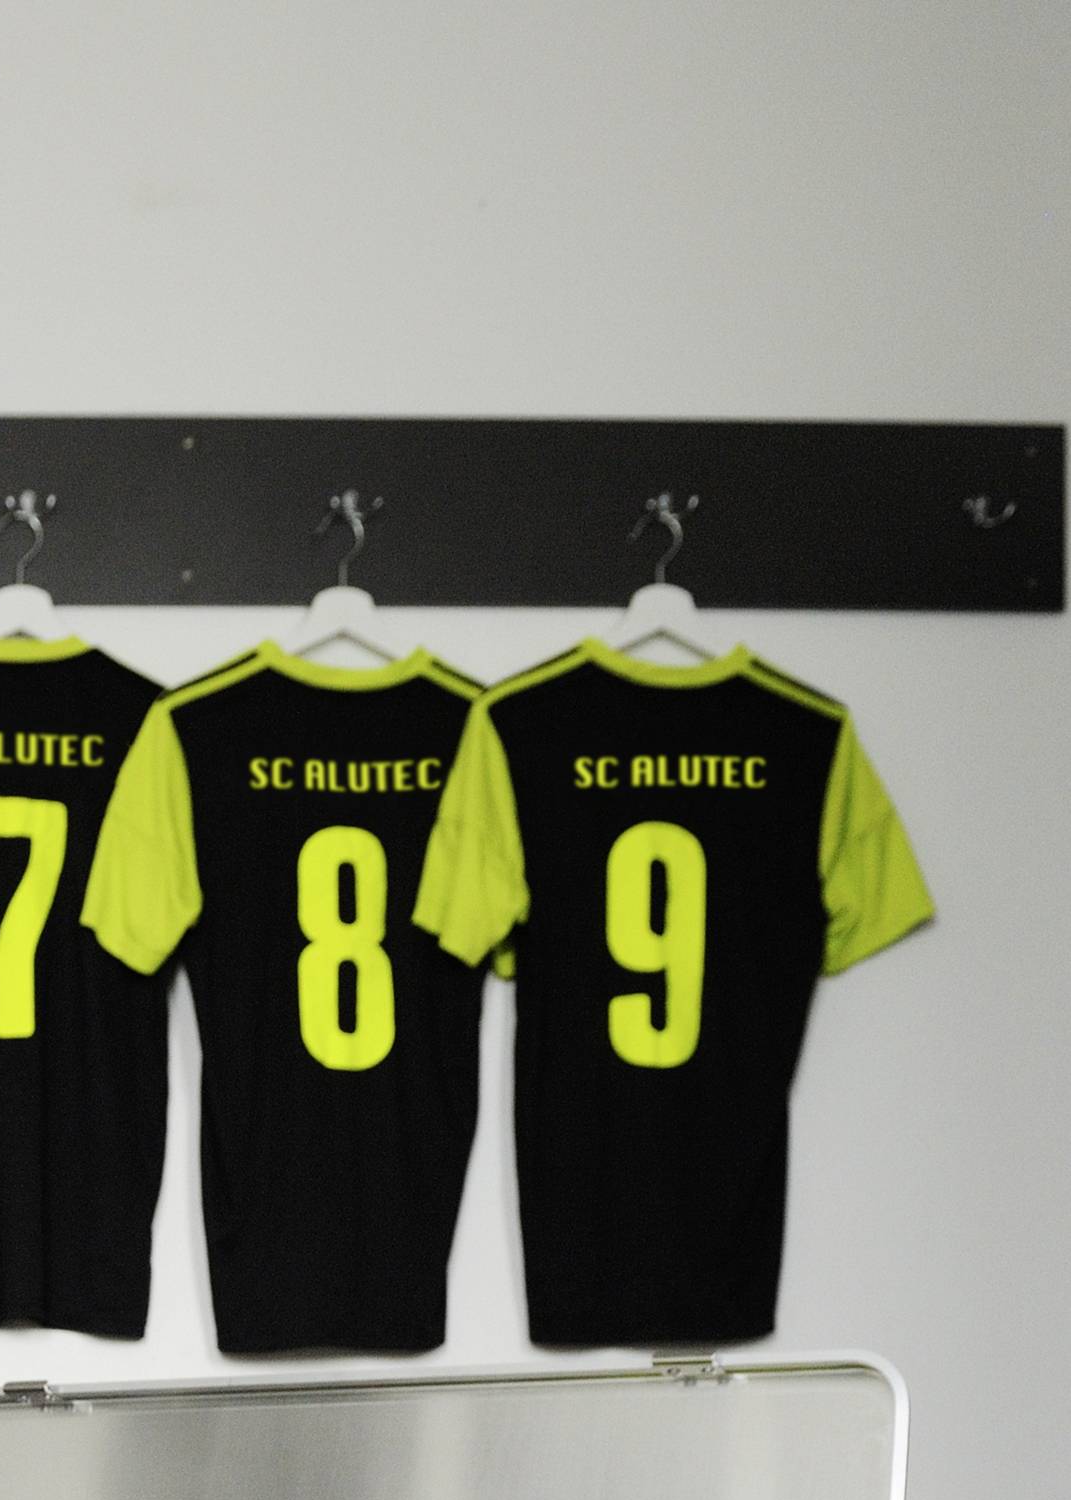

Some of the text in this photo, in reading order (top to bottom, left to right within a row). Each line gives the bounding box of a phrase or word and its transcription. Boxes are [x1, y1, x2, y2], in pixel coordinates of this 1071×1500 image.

[249, 756, 441, 793] SC ALUTEC
[573, 755, 767, 788] SC ALUTEC
[297, 825, 395, 1071] 8
[605, 821, 707, 1068] 9
